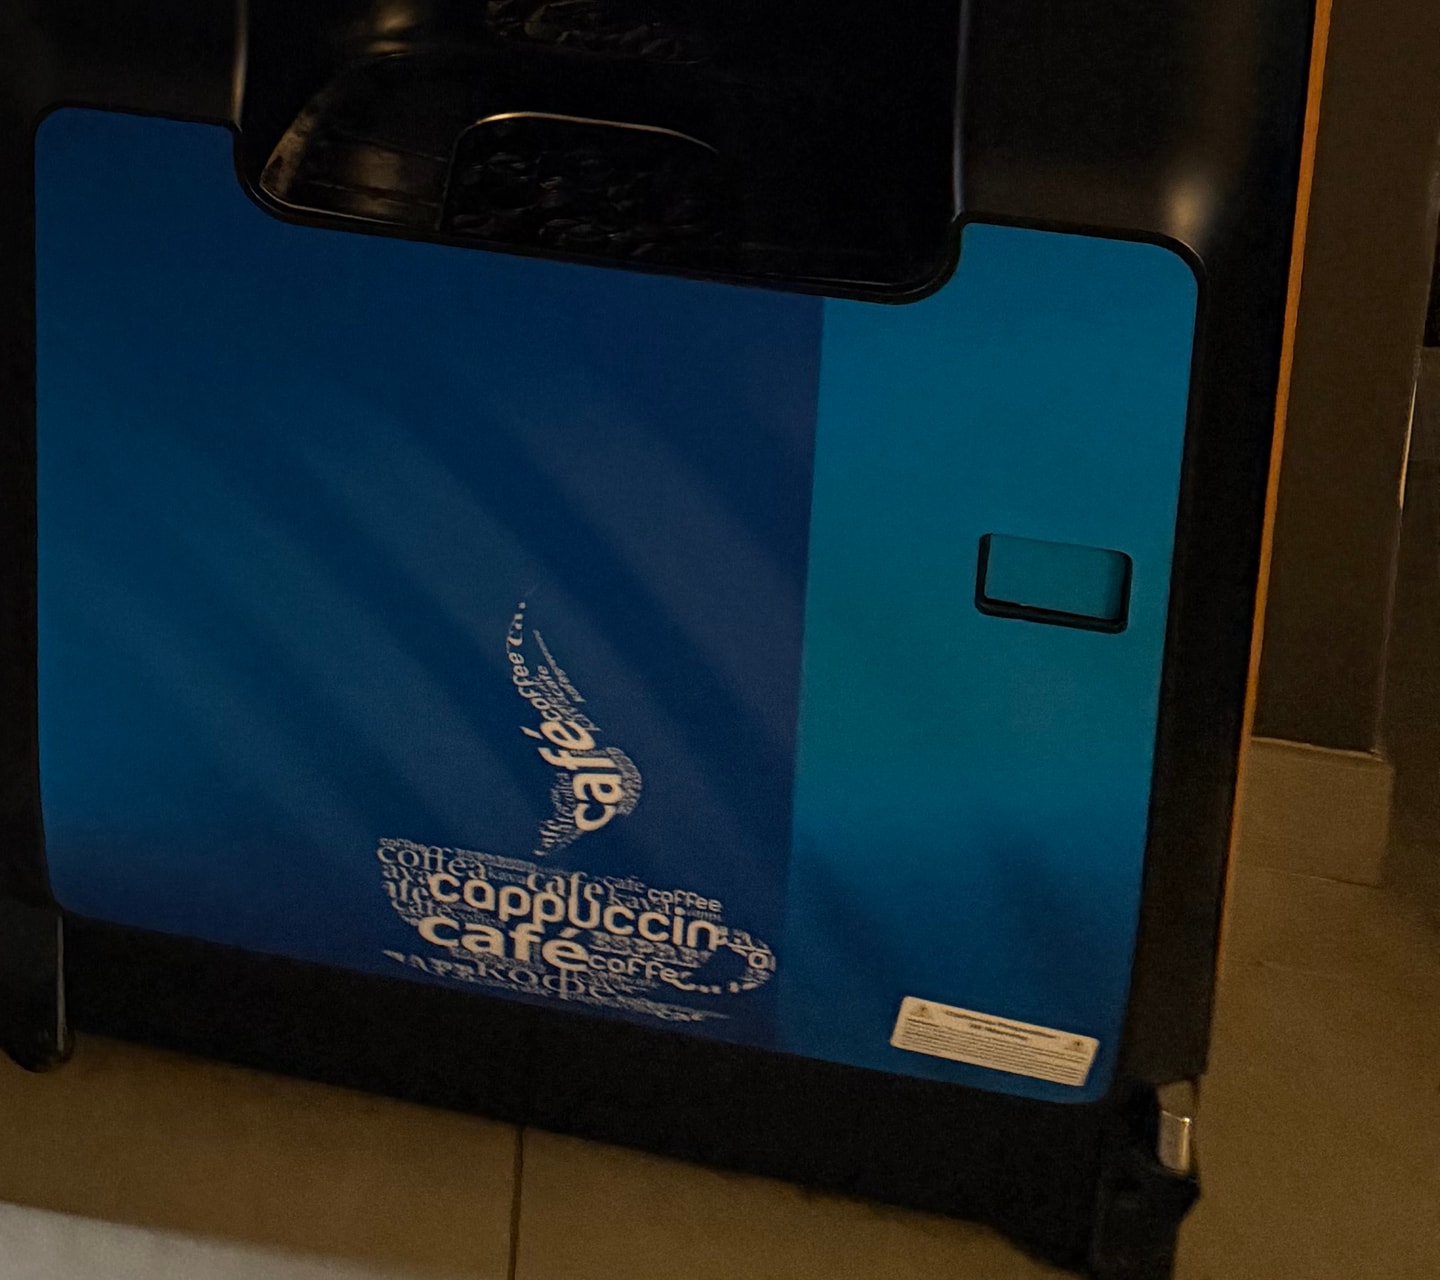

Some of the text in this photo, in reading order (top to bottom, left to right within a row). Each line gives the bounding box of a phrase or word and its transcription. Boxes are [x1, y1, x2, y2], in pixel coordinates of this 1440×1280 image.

[520, 720, 624, 832] café
[647, 889, 723, 913] coffee
[418, 915, 590, 972] café
